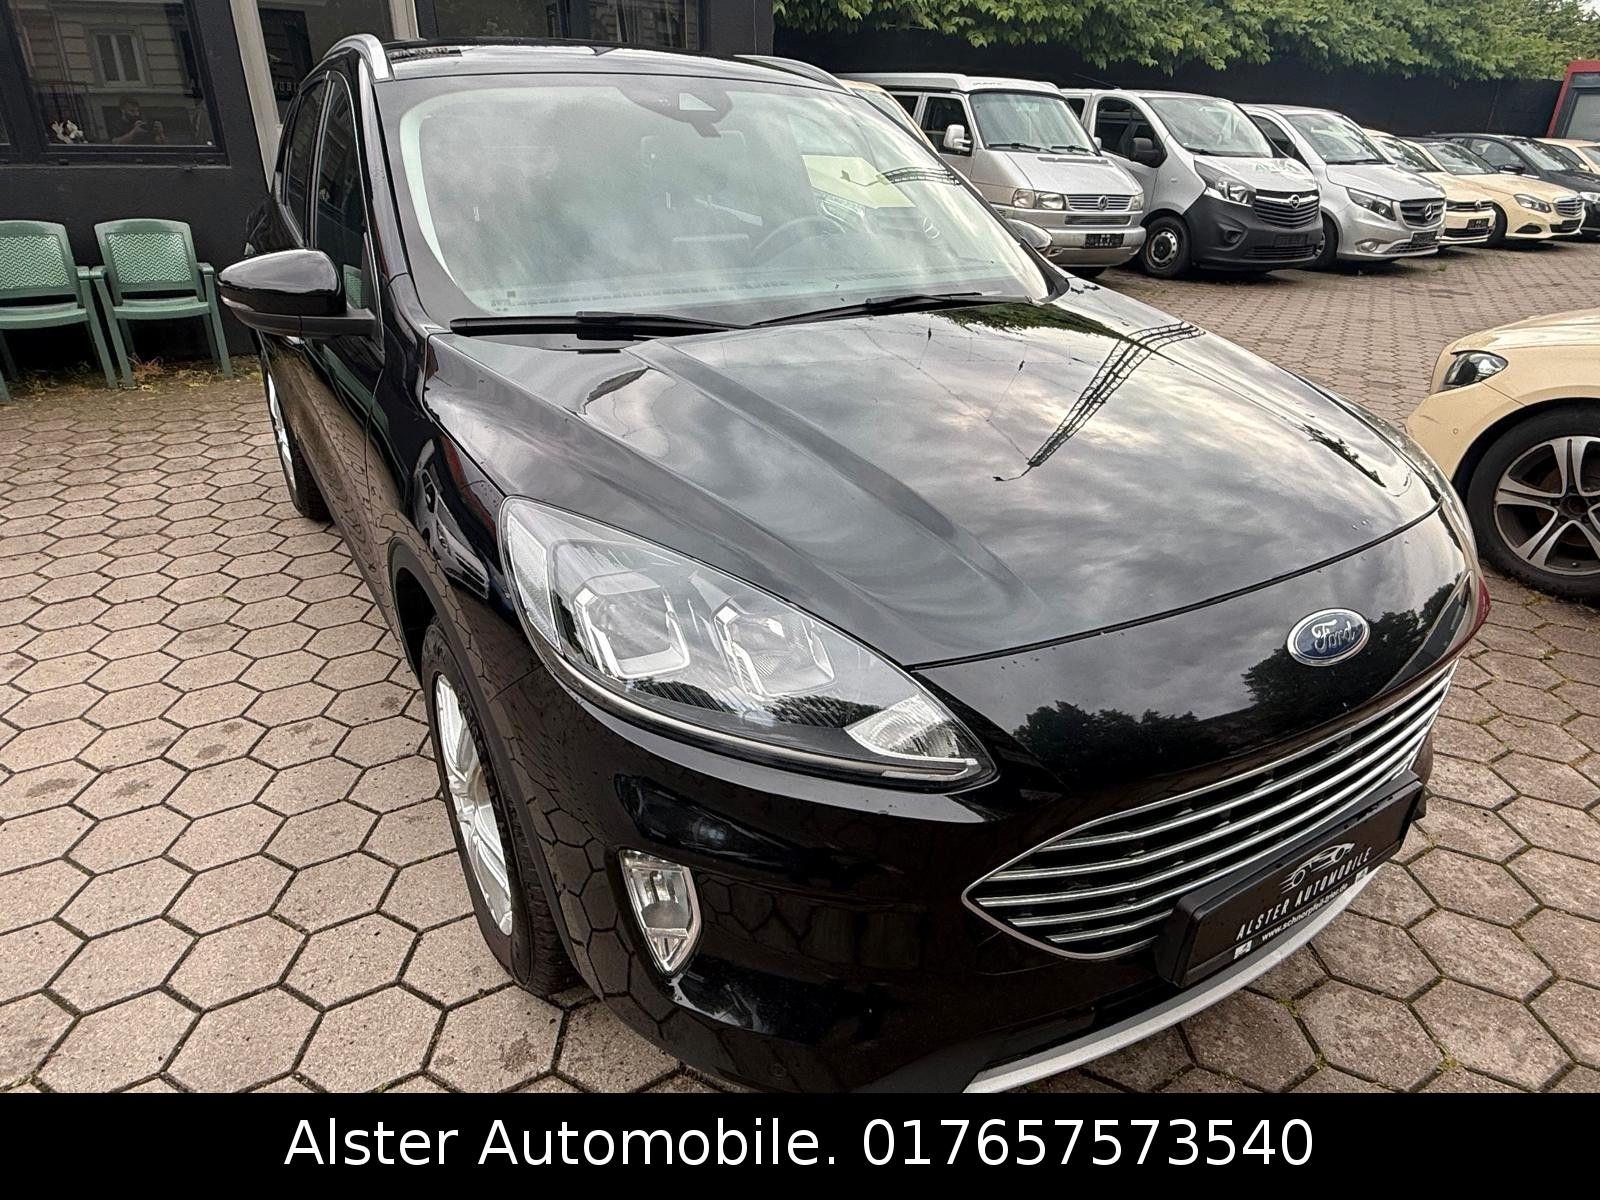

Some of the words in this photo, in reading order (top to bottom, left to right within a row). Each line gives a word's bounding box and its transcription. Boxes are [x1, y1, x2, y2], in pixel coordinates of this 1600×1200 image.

[1311, 619, 1355, 654] Ford
[1236, 898, 1290, 941] ALSTER
[1294, 846, 1373, 908] AUTOMOBILE
